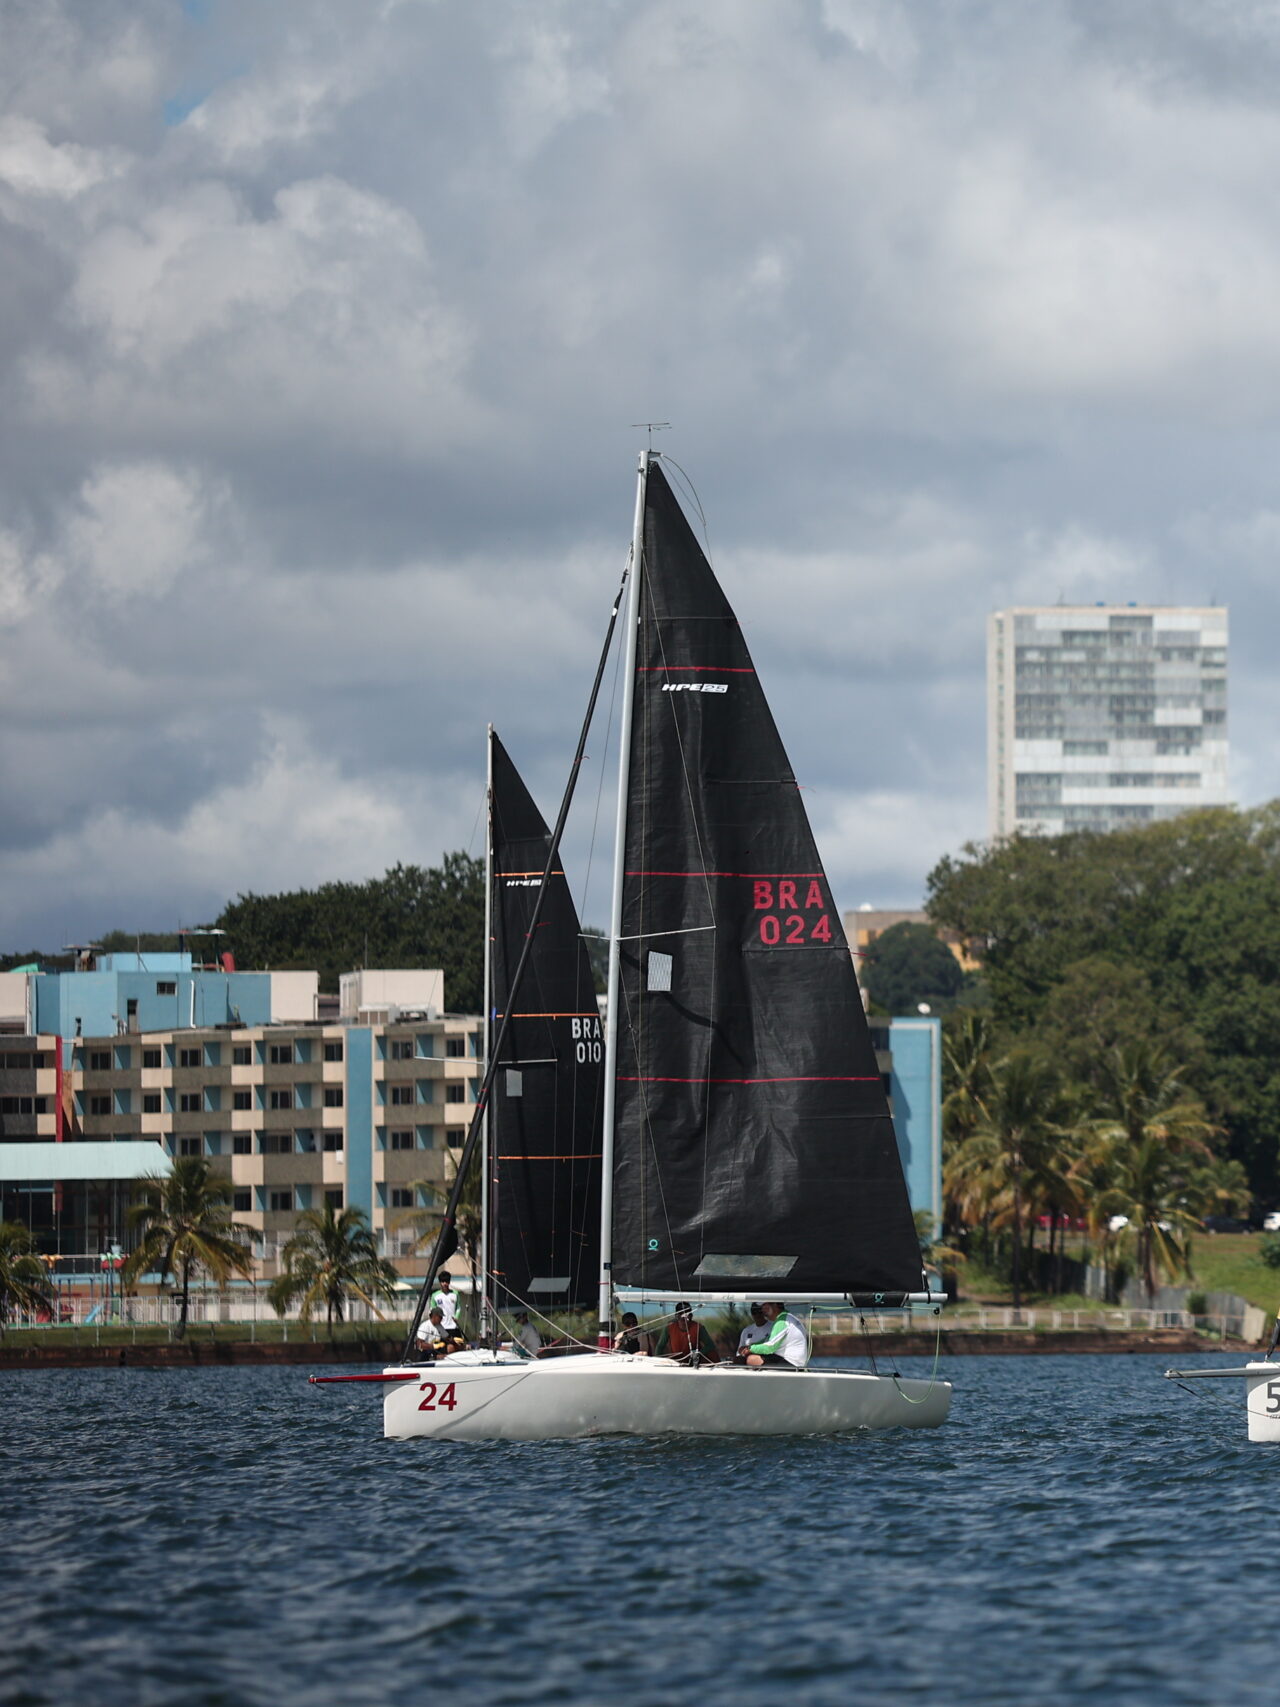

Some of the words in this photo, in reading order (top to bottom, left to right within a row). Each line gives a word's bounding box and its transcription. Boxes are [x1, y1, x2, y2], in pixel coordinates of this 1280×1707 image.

[753, 880, 824, 910] BRA
[760, 914, 832, 945] 024
[571, 1017, 601, 1039] BRA
[576, 1041, 602, 1064] 010
[417, 1382, 457, 1412] 24
